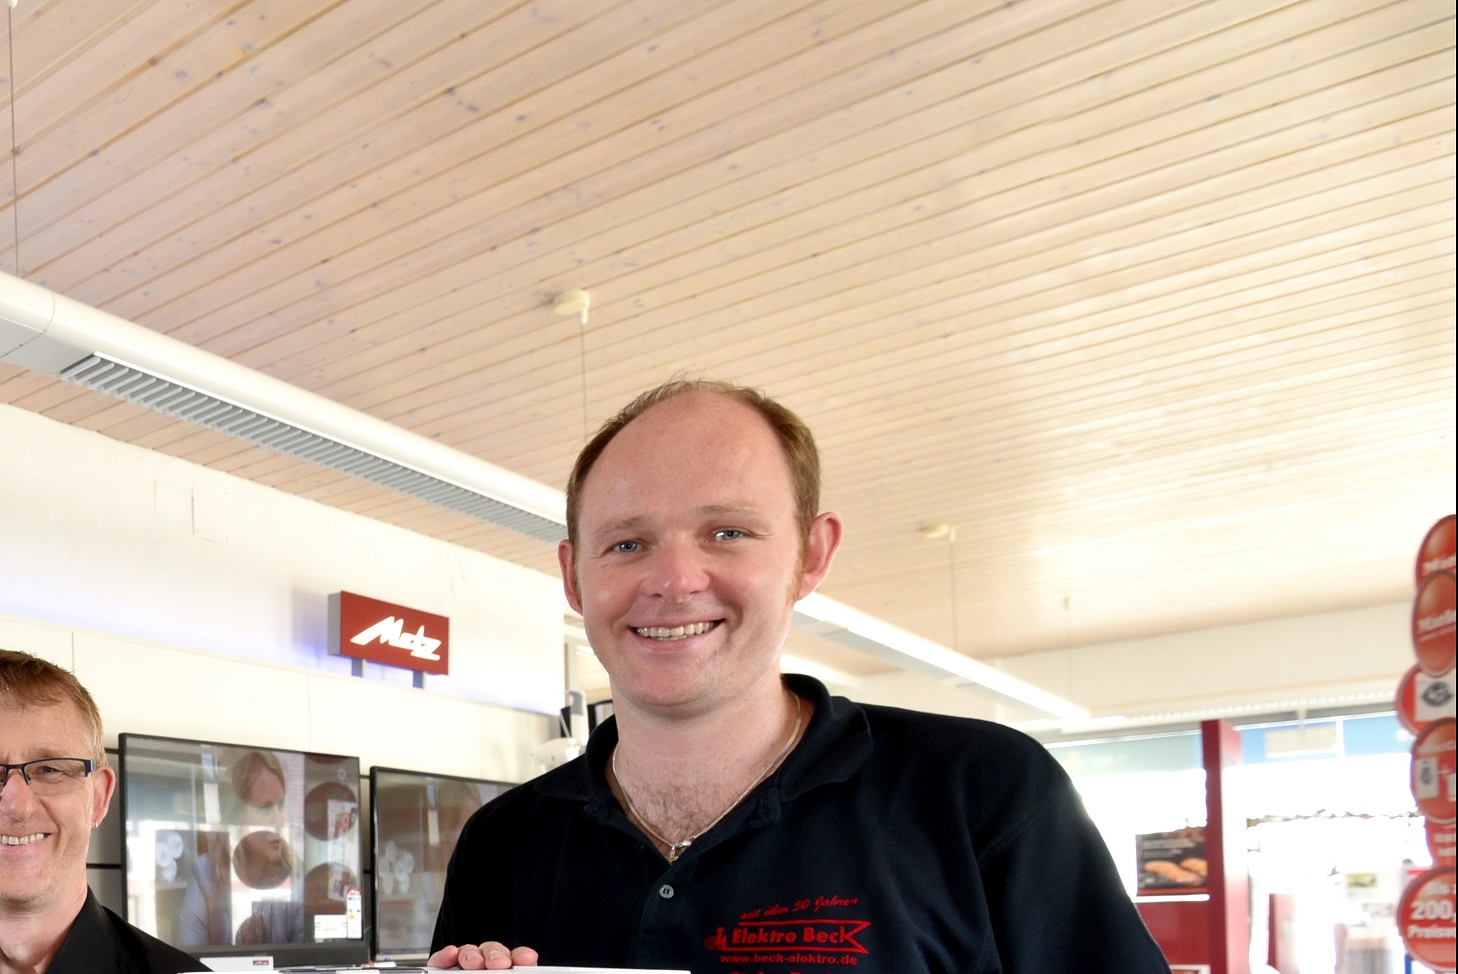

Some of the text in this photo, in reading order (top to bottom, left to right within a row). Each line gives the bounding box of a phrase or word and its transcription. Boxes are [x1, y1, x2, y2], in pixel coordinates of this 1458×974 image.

[349, 615, 442, 662] Metz
[813, 894, 859, 912] Jahren
[731, 927, 847, 944] Elektro Beck
[720, 953, 858, 966] www.beck-elektro.de
